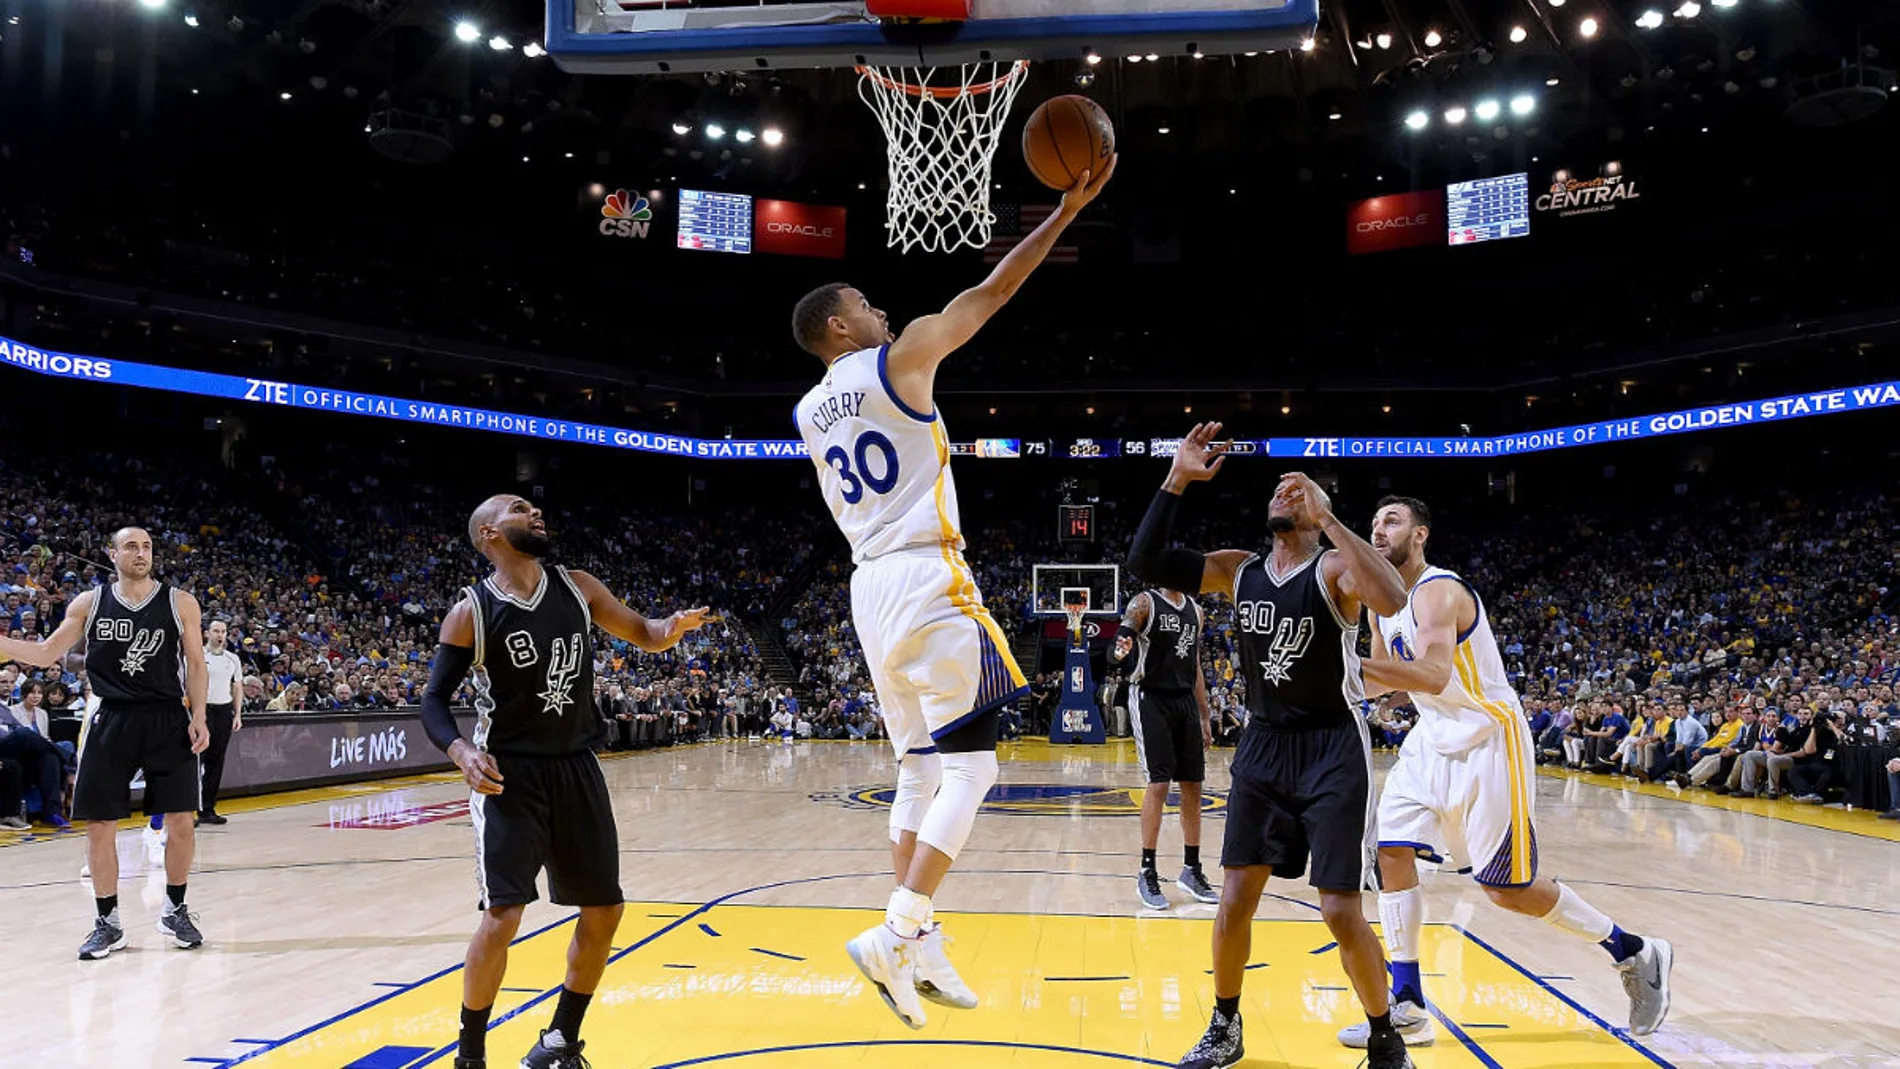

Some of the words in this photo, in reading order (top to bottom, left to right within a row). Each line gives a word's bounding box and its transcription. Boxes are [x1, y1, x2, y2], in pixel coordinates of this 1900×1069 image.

[1535, 182, 1640, 211] CENTRAL
[600, 219, 649, 239] CSN
[767, 222, 834, 238] ORACLE
[1356, 213, 1429, 233] ORACLE
[244, 378, 289, 404] ZTE
[303, 391, 399, 416] OFFICIAL
[408, 404, 537, 433] SMARTPHONE
[545, 422, 567, 437] OF
[575, 426, 606, 442] THE
[613, 431, 693, 454] GOLDEN
[697, 442, 757, 456] STATE
[812, 392, 866, 433] CURRY
[1304, 438, 1339, 457] ZTE
[1351, 441, 1436, 454] OFFICIAL
[1443, 432, 1565, 454] SMARTPHONE
[1573, 427, 1597, 443] OF
[1605, 420, 1640, 438] THE
[1649, 405, 1753, 432] GOLDEN
[1760, 391, 1846, 418] STATE
[1026, 442, 1045, 454] 75
[1069, 445, 1100, 457] 3:22
[1125, 442, 1145, 454] 56
[825, 430, 899, 504] 30
[1071, 520, 1087, 536] 14
[1159, 614, 1180, 632] 12
[1238, 600, 1275, 634] 30
[96, 619, 133, 641] 20
[505, 630, 538, 668] 8
